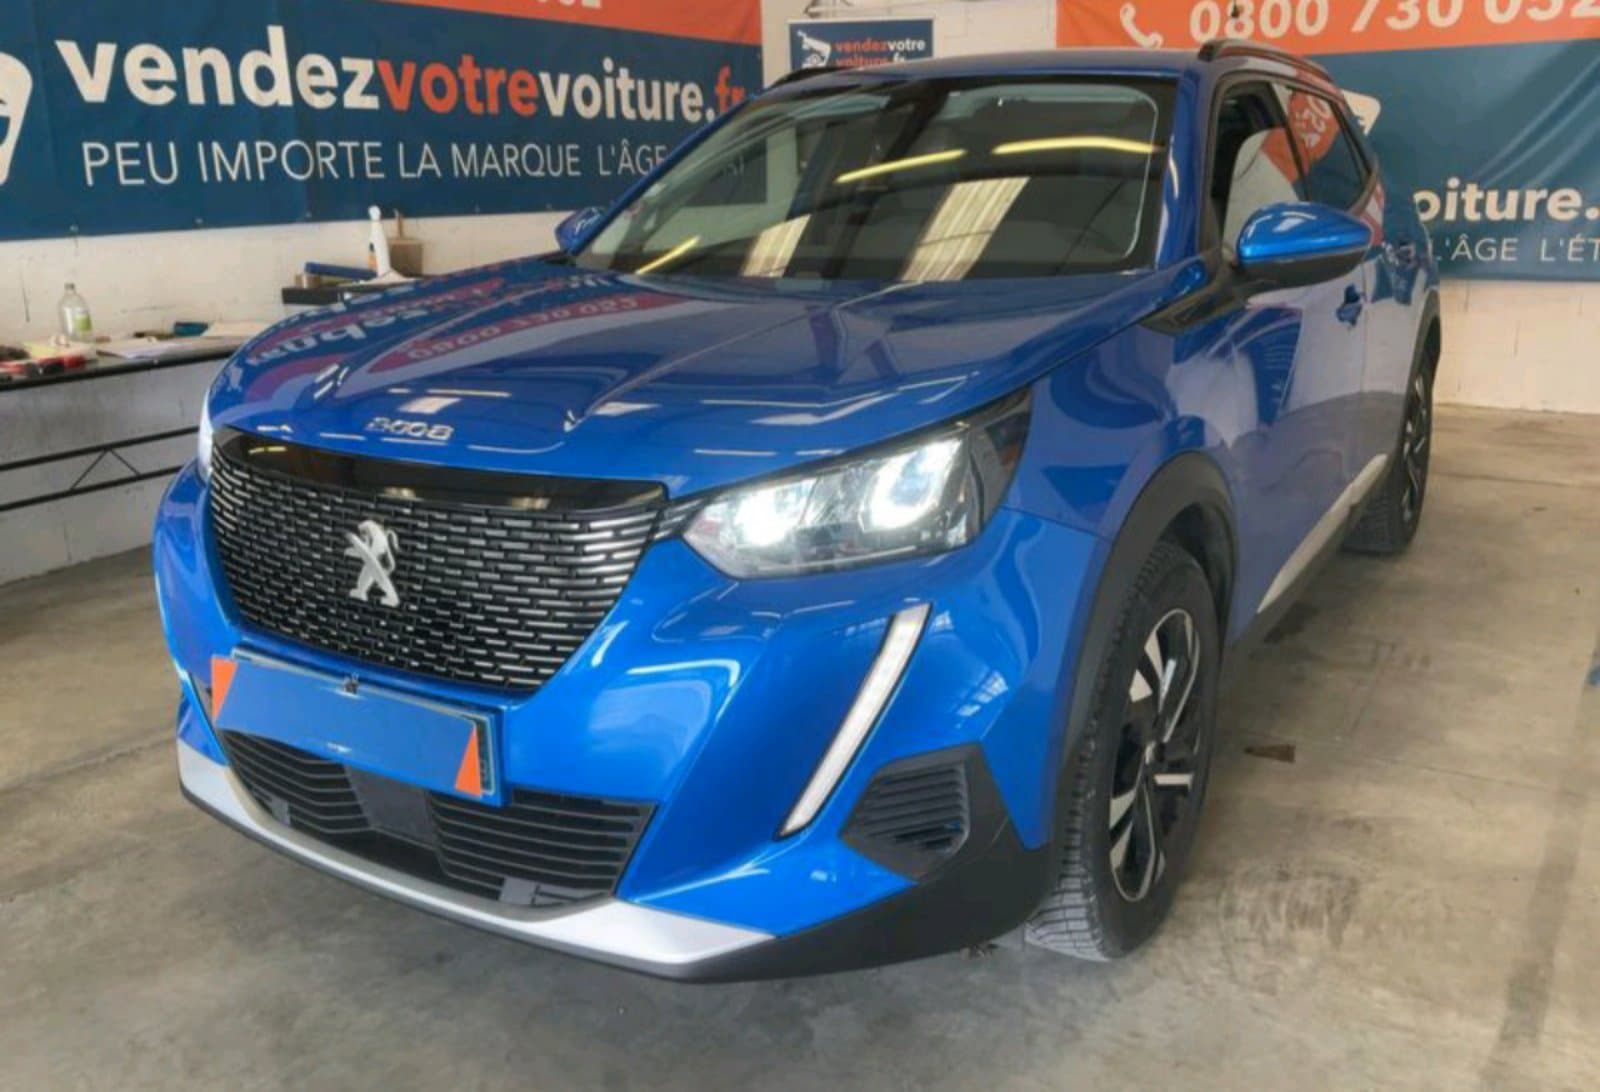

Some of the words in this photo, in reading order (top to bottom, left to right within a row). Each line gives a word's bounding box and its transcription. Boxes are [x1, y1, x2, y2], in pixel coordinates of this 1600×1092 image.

[1189, 0, 1329, 43] 0800
[82, 141, 179, 187] PEU
[198, 140, 386, 182] IMPORTE
[398, 142, 442, 178] LA
[451, 143, 582, 178] MARQUE
[1436, 233, 1519, 262] 'ÂGE
